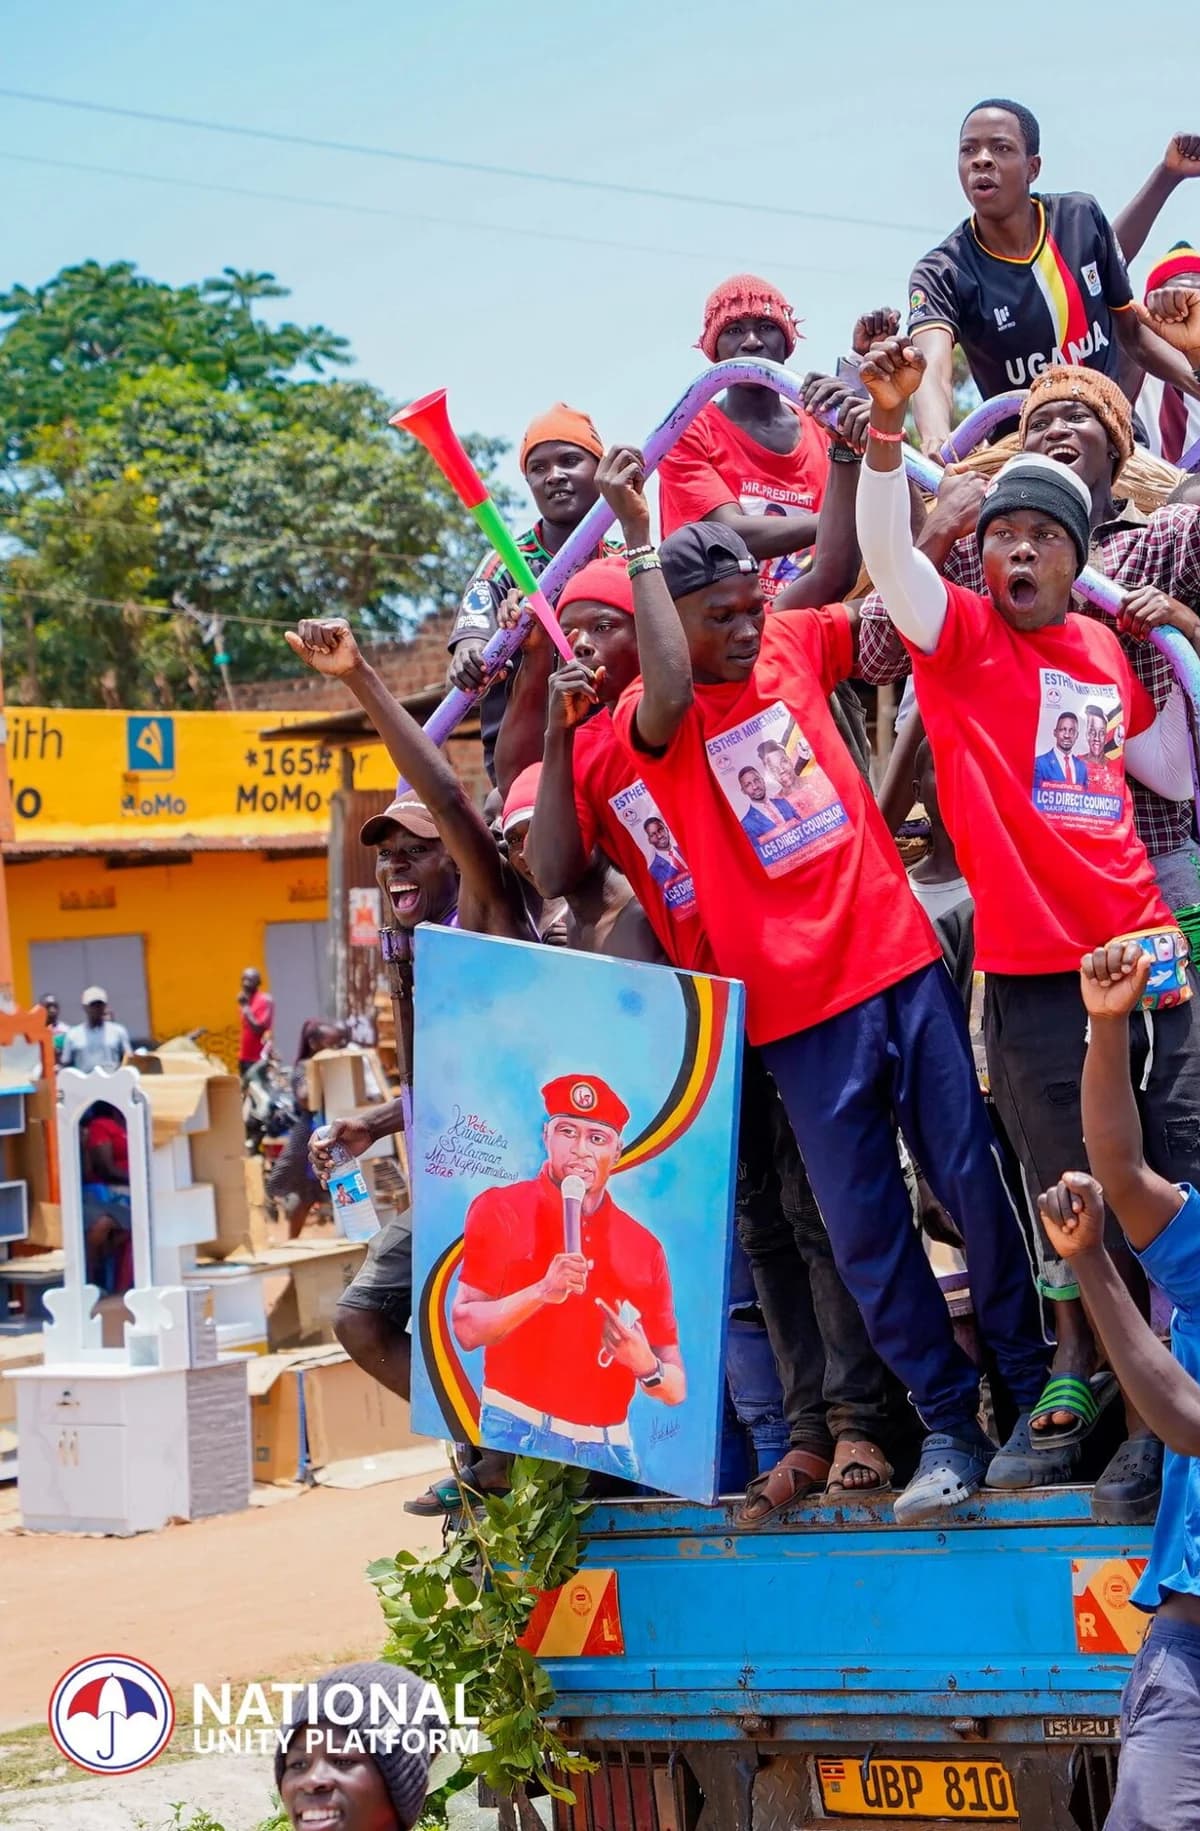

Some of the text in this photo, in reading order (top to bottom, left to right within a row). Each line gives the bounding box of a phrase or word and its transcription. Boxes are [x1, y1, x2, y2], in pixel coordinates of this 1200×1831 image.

[7, 716, 63, 760] ith
[707, 706, 786, 756] ESTHER MIREMBE
[236, 783, 321, 812] MoMo
[1037, 790, 1055, 804] LC5
[1055, 792, 1083, 808] DIRECT
[760, 841, 779, 858] LC5
[775, 826, 804, 851] DIRECT
[802, 804, 844, 836] COUNCILOR
[425, 1163, 455, 1178] 2026
[603, 1618, 617, 1641] L
[1079, 1613, 1098, 1637] R
[1048, 1719, 1110, 1736] ISUZU
[858, 1764, 1019, 1812] UBP 810
